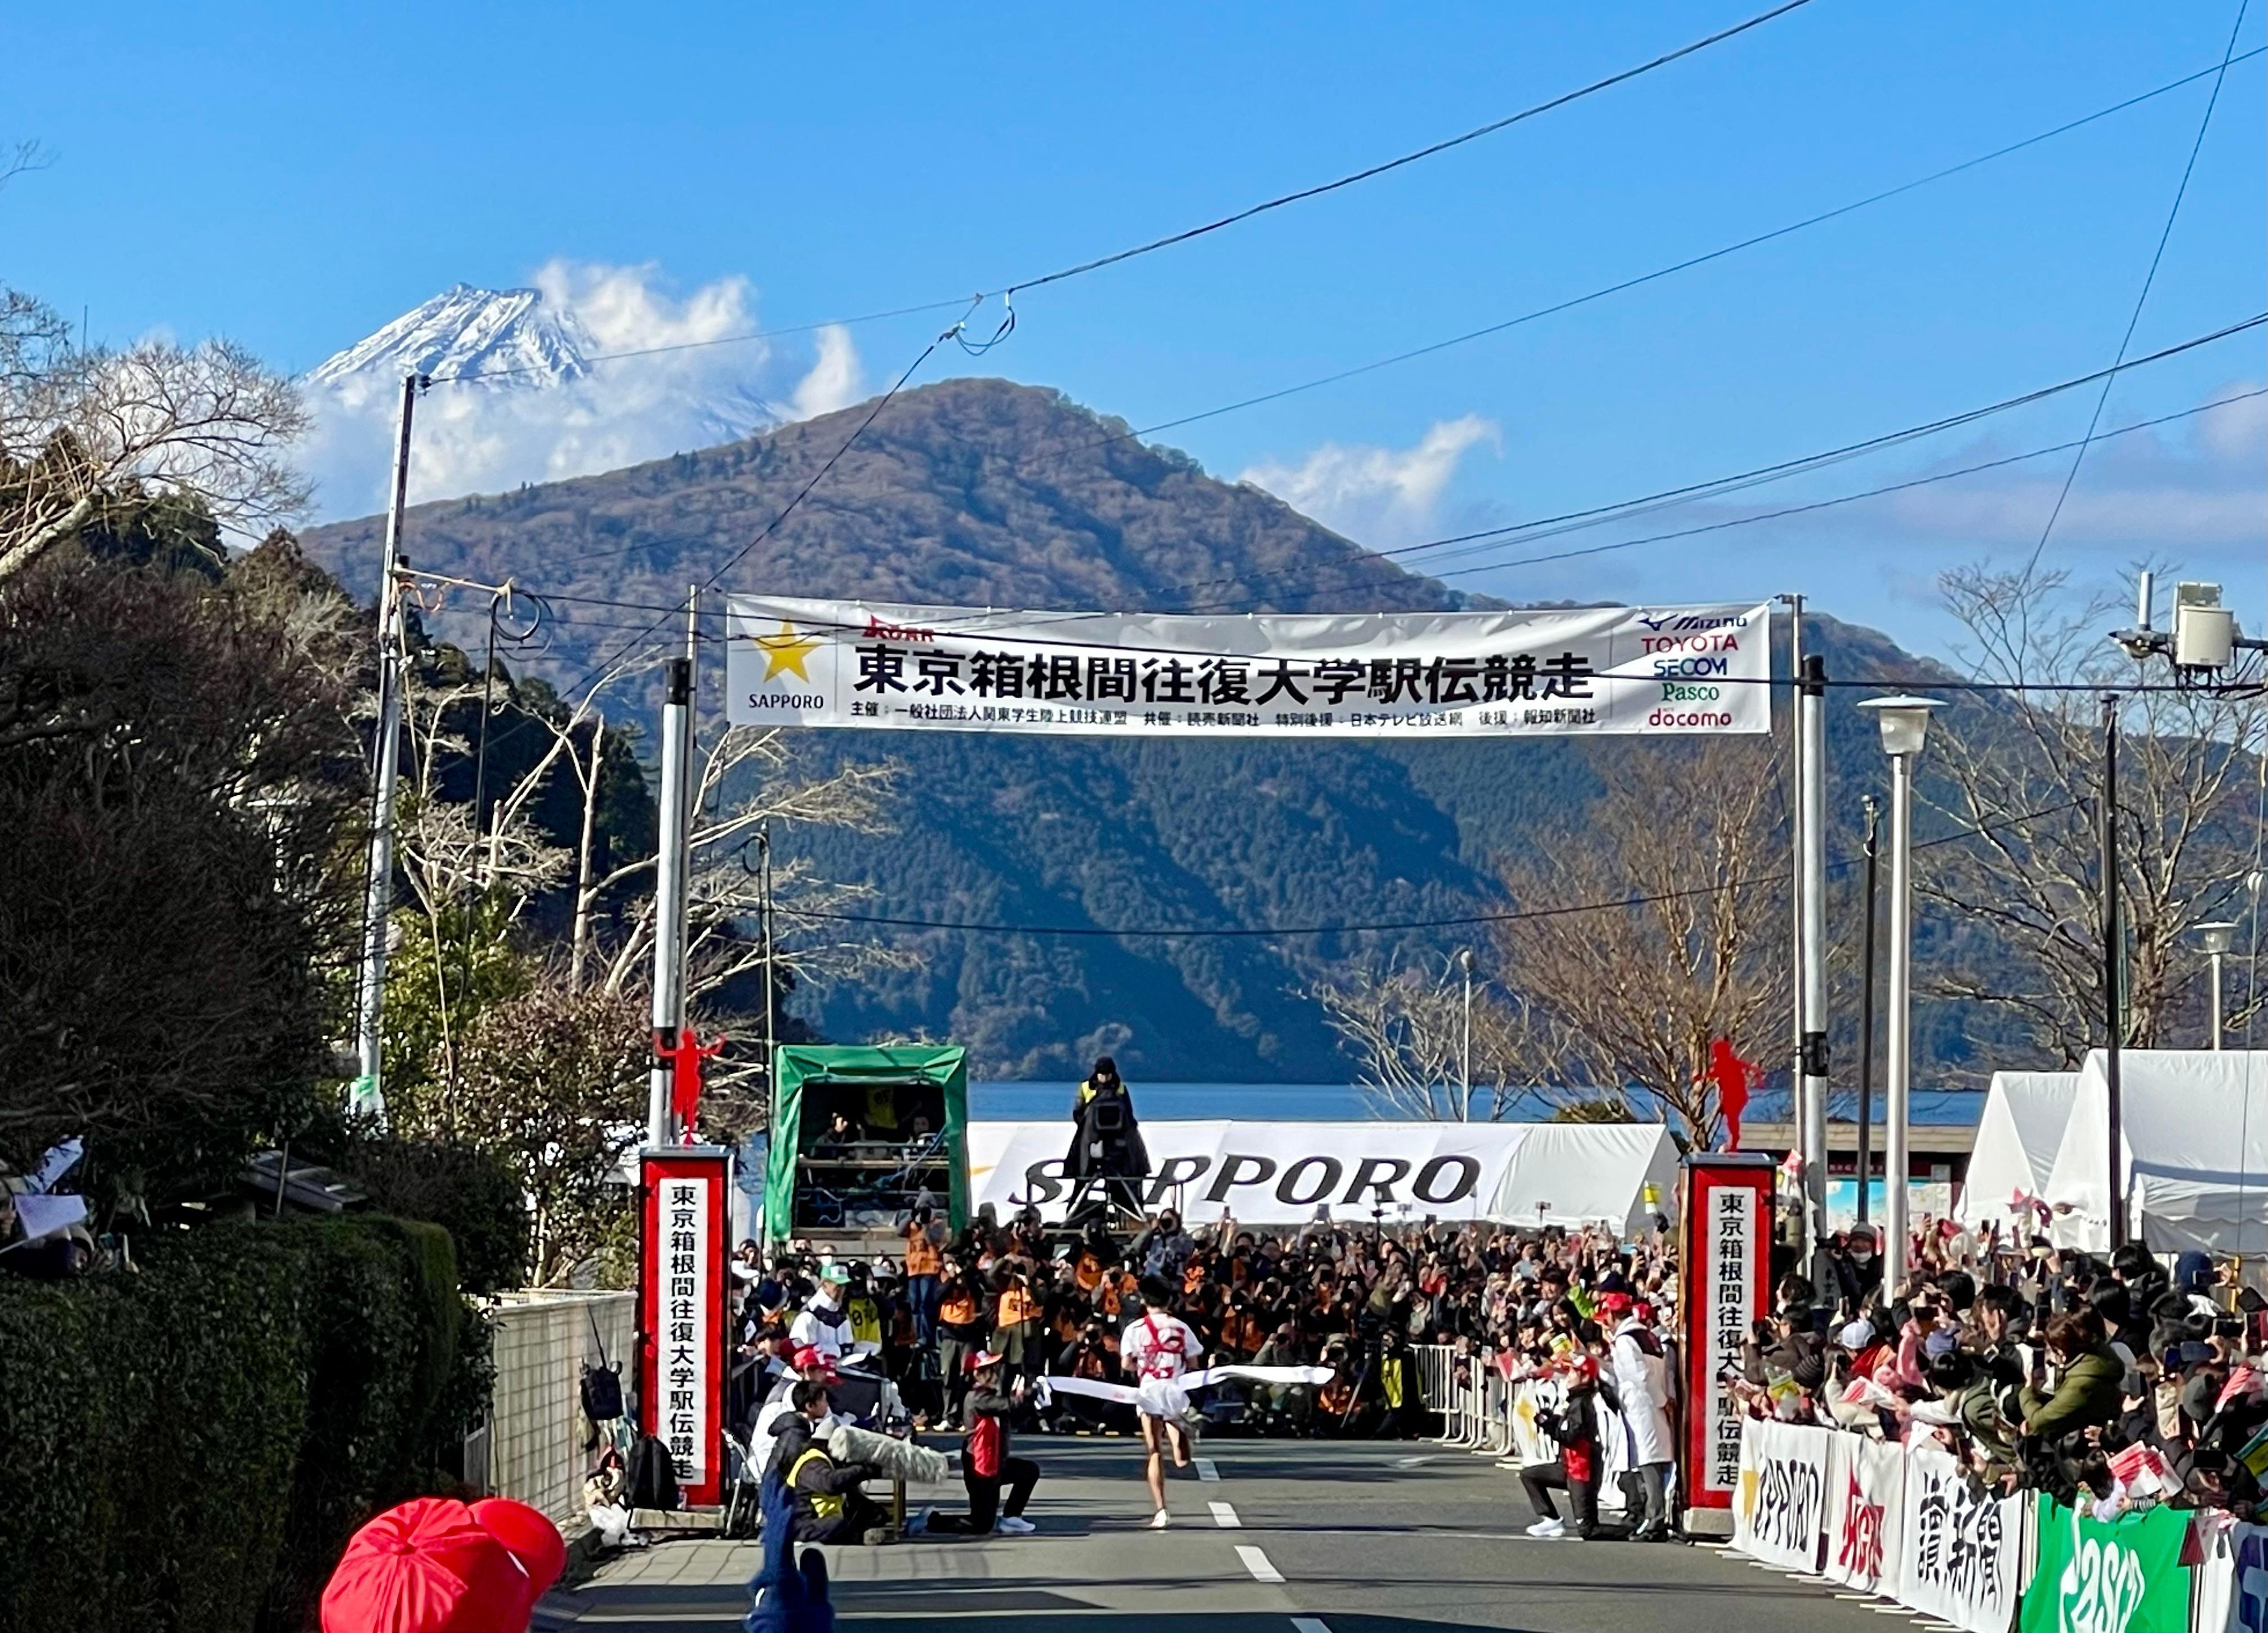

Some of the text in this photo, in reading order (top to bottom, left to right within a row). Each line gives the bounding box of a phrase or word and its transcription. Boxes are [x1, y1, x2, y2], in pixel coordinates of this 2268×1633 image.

[1641, 634, 1739, 655] TOYOTA
[854, 643, 1594, 705] 東京箱根間往復大学駅伝競走
[1654, 657, 1727, 677] SECOM
[748, 694, 824, 709] SAPPORO
[1662, 682, 1719, 701] Pasco
[1648, 708, 1732, 727] docomo
[1007, 1154, 1481, 1205] SPPORO
[1716, 1194, 1745, 1485] 東京箱根間往復大駅伝競走
